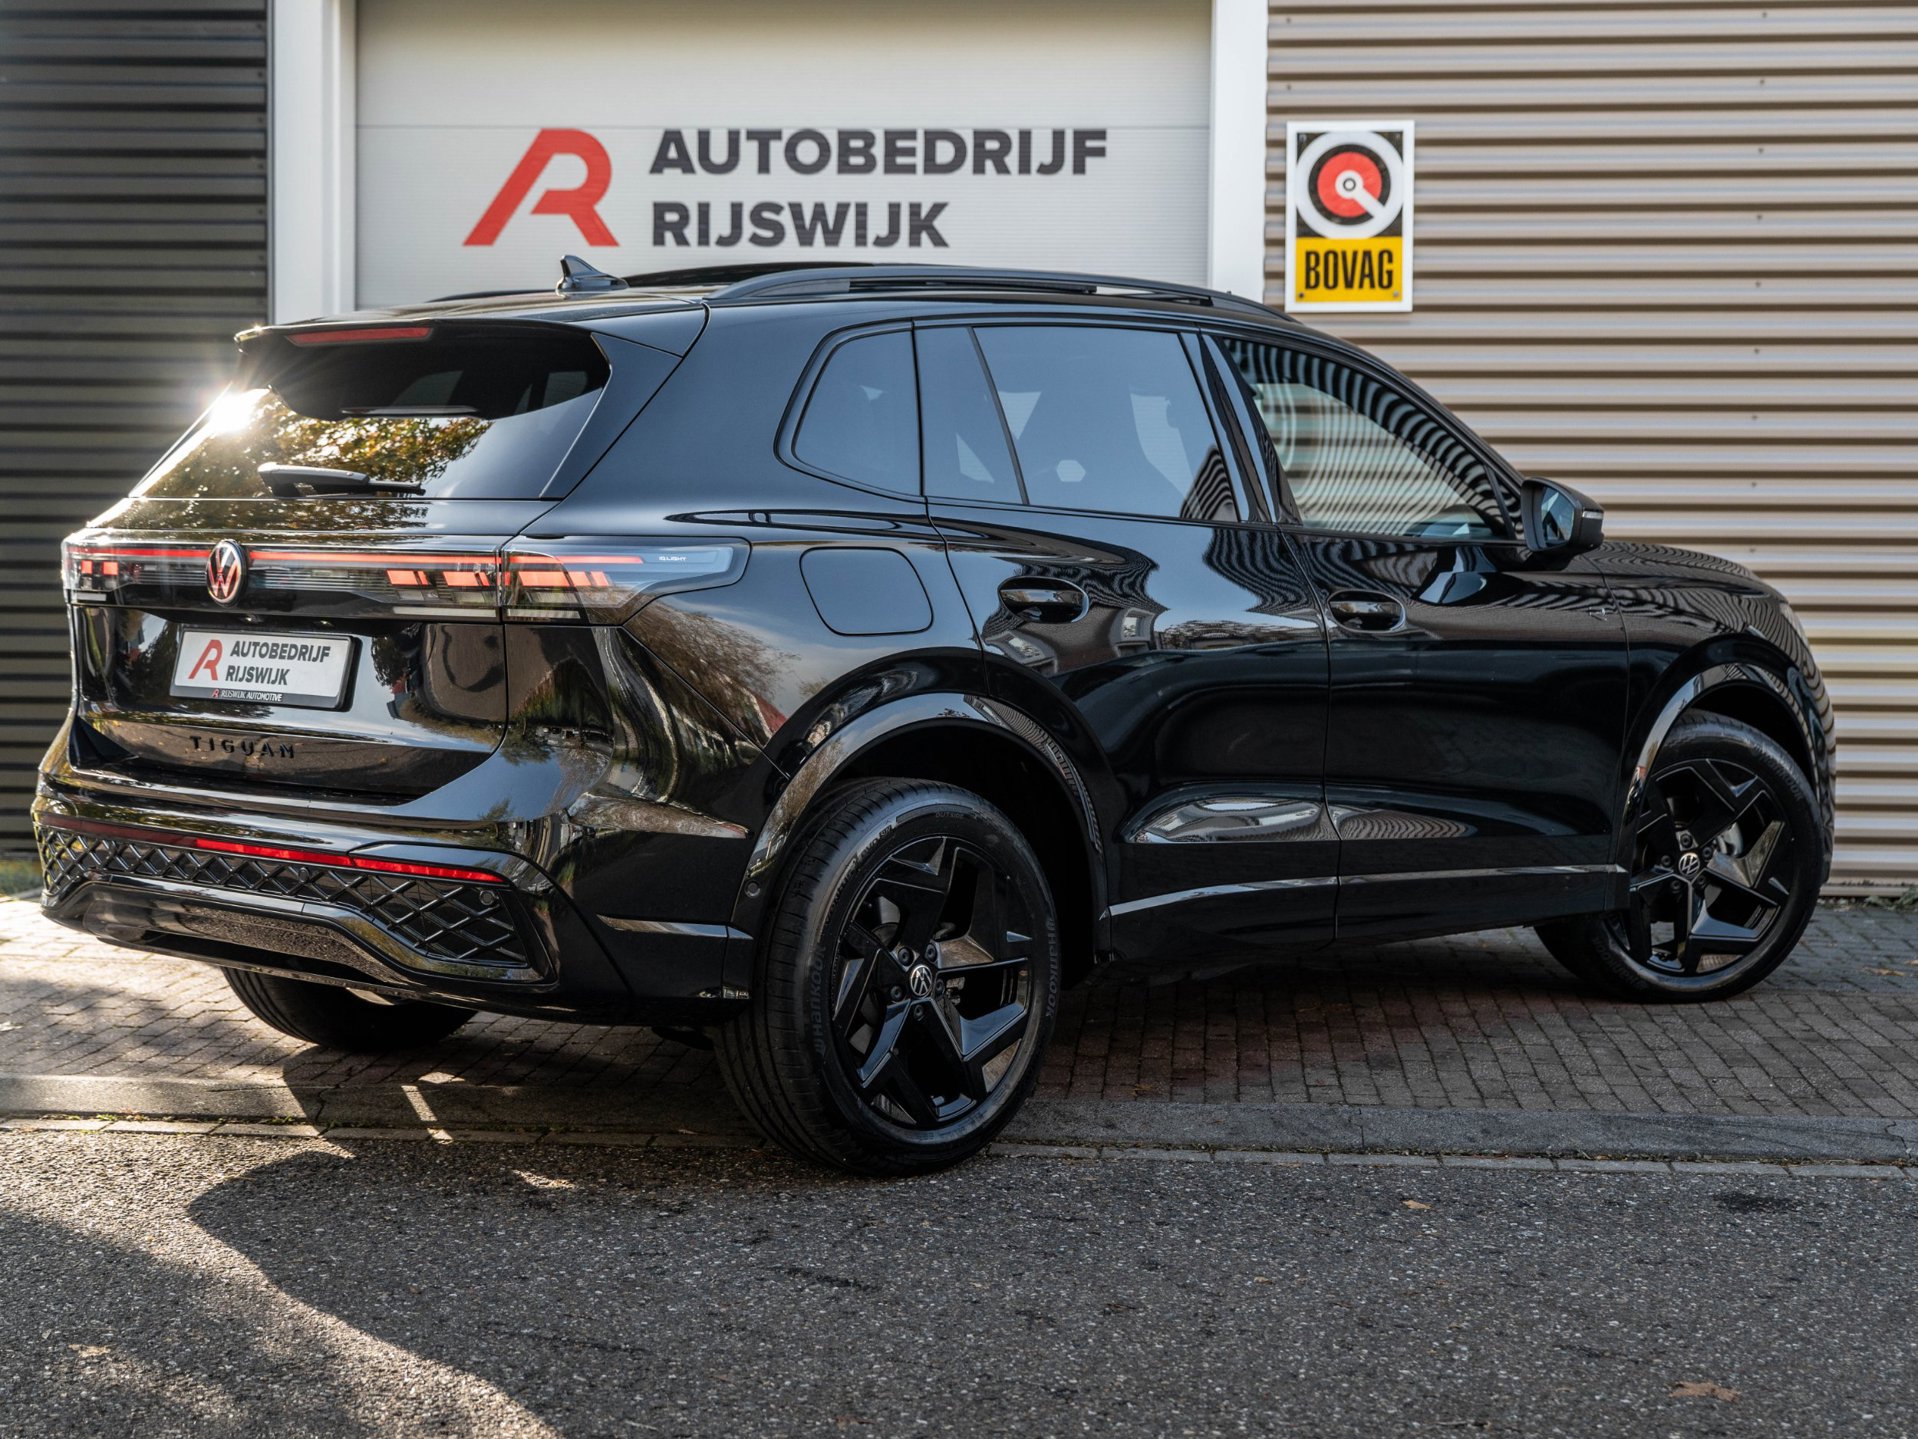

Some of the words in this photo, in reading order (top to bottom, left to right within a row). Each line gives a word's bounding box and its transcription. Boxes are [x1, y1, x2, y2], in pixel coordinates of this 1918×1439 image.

[649, 128, 1108, 176] AUTOBEDRIJF
[651, 201, 950, 248] RIJSWIJK
[1304, 249, 1394, 291] BOVAG
[229, 640, 332, 663] AUTOBEDRIJF
[225, 665, 291, 686] RIJSWIJK
[246, 691, 283, 702] AUTOMOTIVE
[189, 735, 295, 759] TIGUAN
